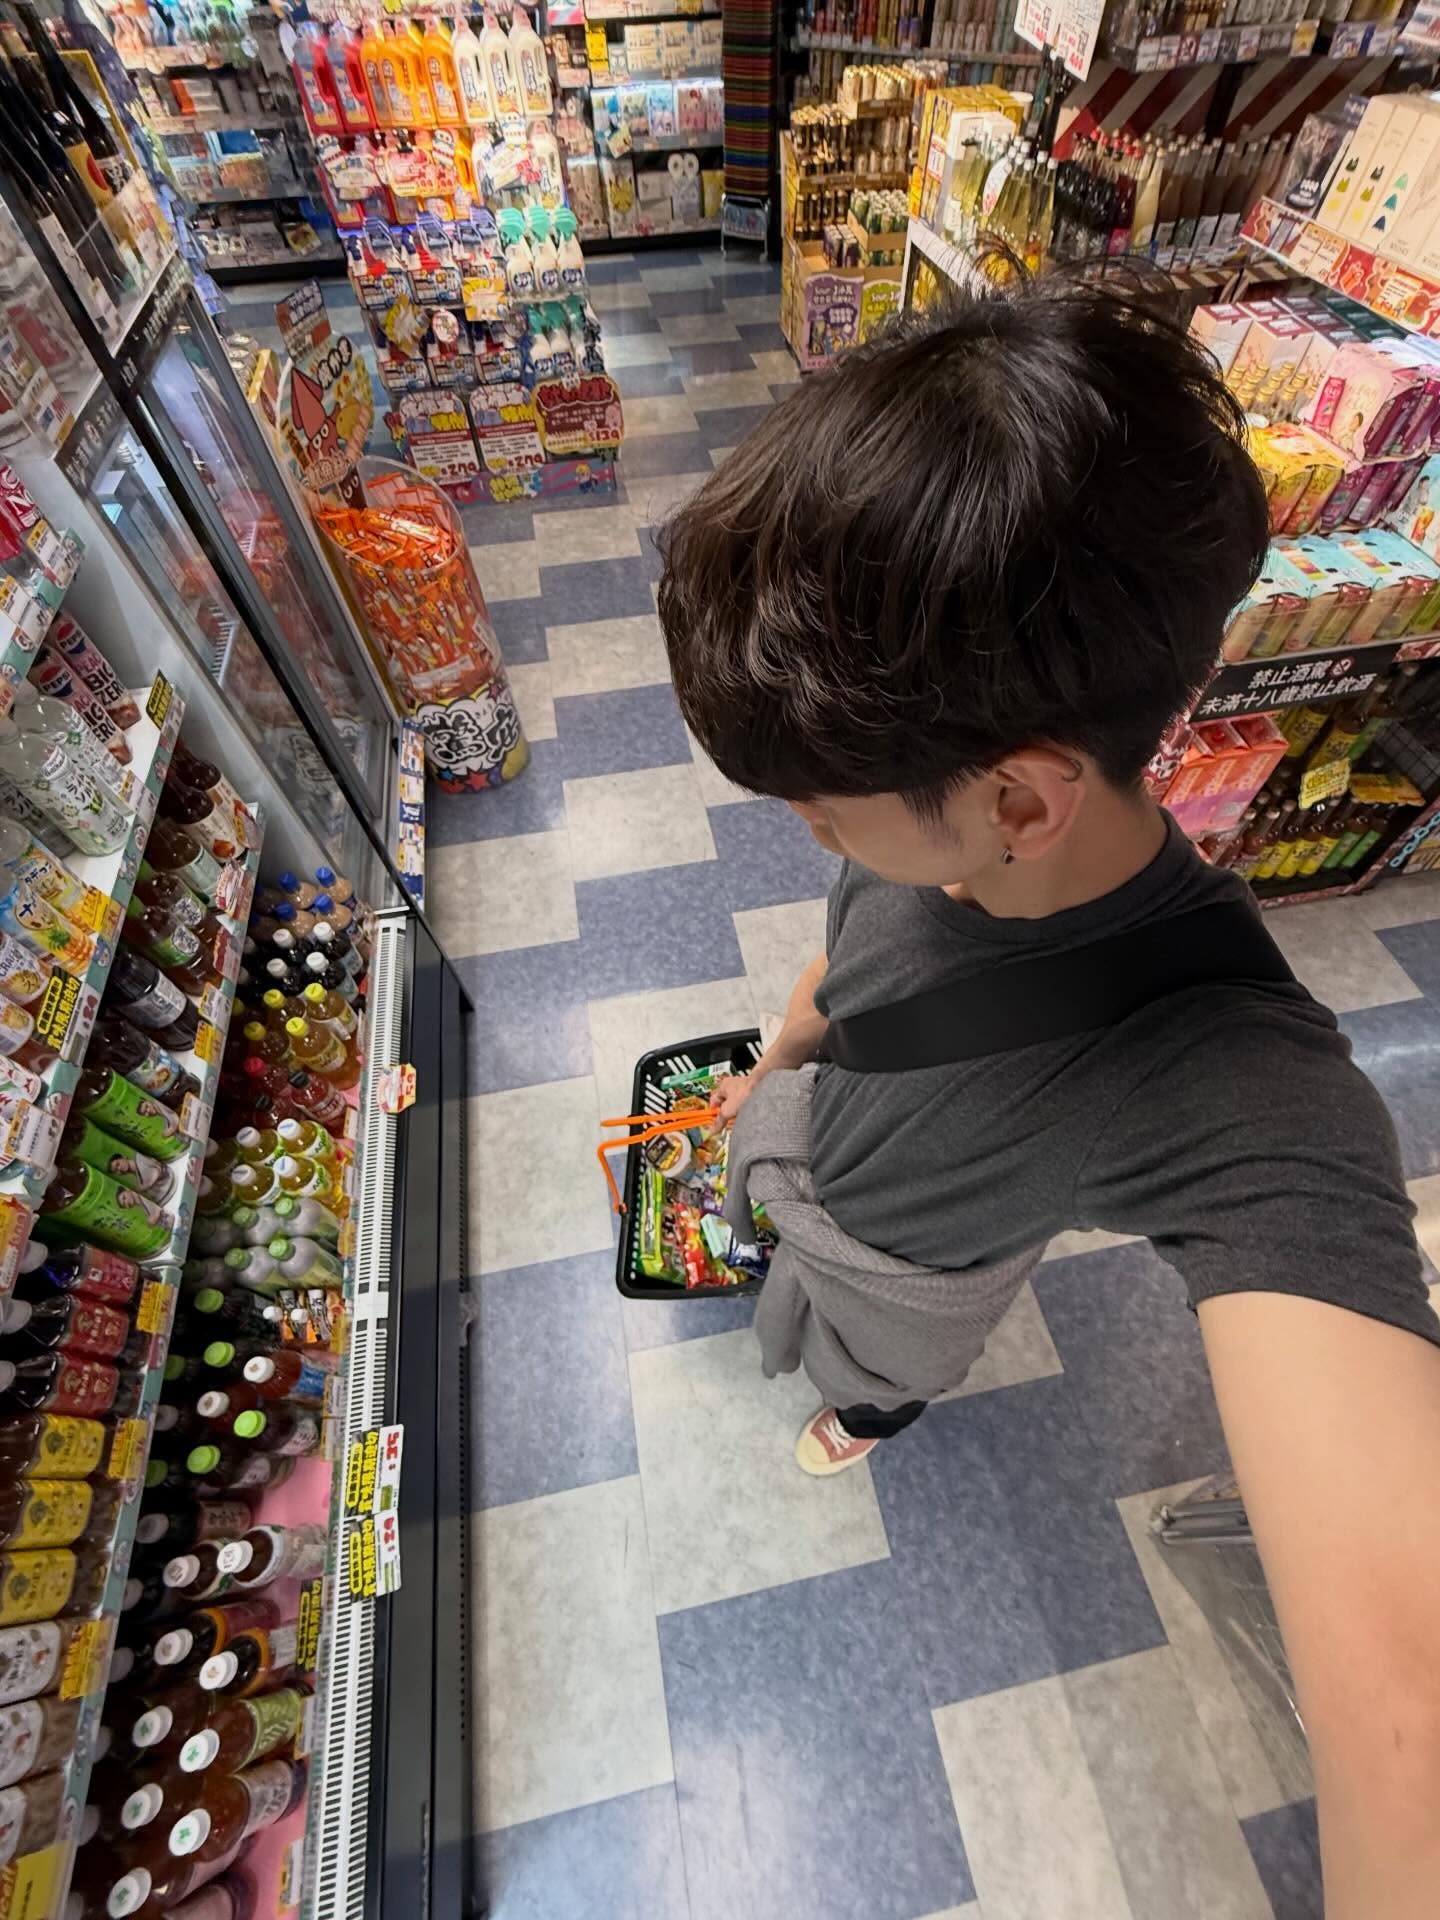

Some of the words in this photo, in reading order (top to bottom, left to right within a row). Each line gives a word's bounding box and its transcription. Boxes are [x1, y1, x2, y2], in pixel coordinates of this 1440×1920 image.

[1248, 659, 1333, 689] 禁止酒駕
[1199, 673, 1377, 715] 未滿十八歲禁止飲酒
